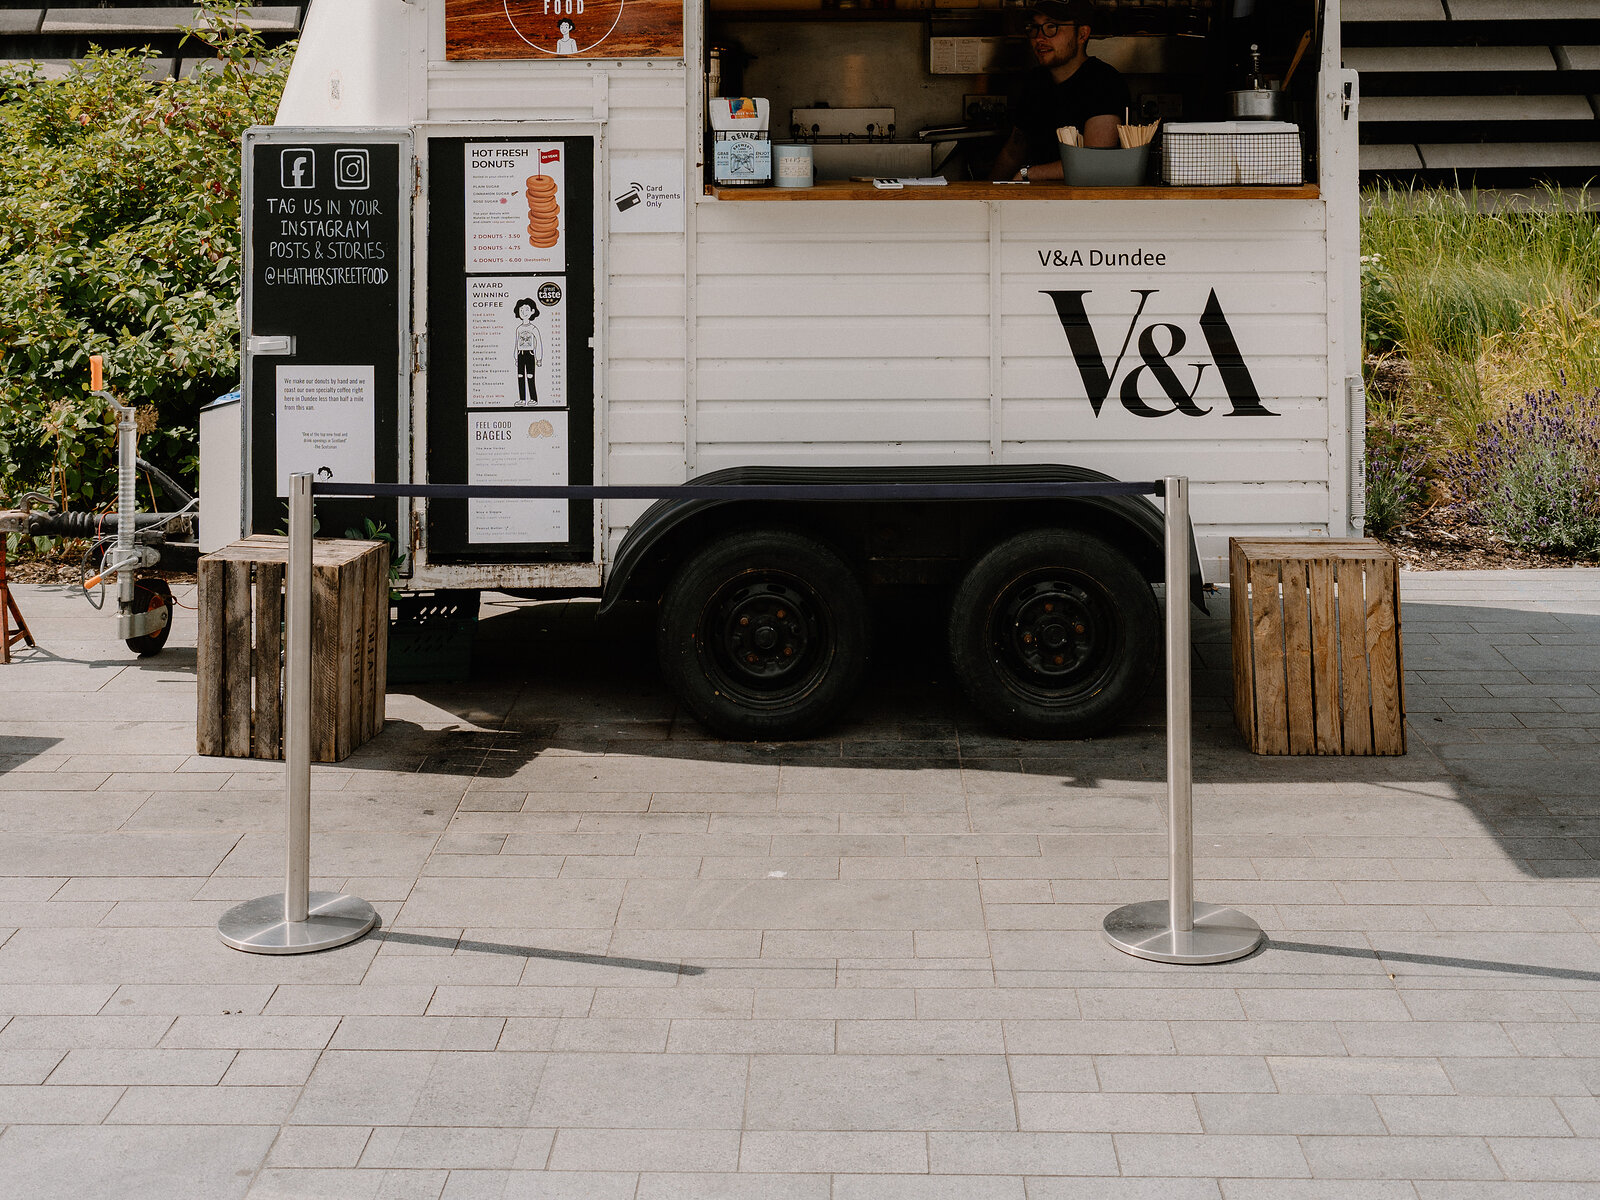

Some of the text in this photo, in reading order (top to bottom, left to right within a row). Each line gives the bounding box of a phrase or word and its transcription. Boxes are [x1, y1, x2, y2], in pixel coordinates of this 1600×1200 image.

[472, 149, 528, 157] HOT FRESH
[472, 160, 515, 168] DONUTS
[266, 198, 382, 216] TAG US IN YOUR
[281, 220, 370, 238] INSTAGRAM
[270, 241, 385, 259] POSTS & STORIES
[1038, 248, 1166, 266] V&A Dundee
[265, 266, 389, 285] @HEATHERSTREETFOOD
[1038, 287, 1282, 418] V&A
[476, 430, 512, 440] BAGELS
